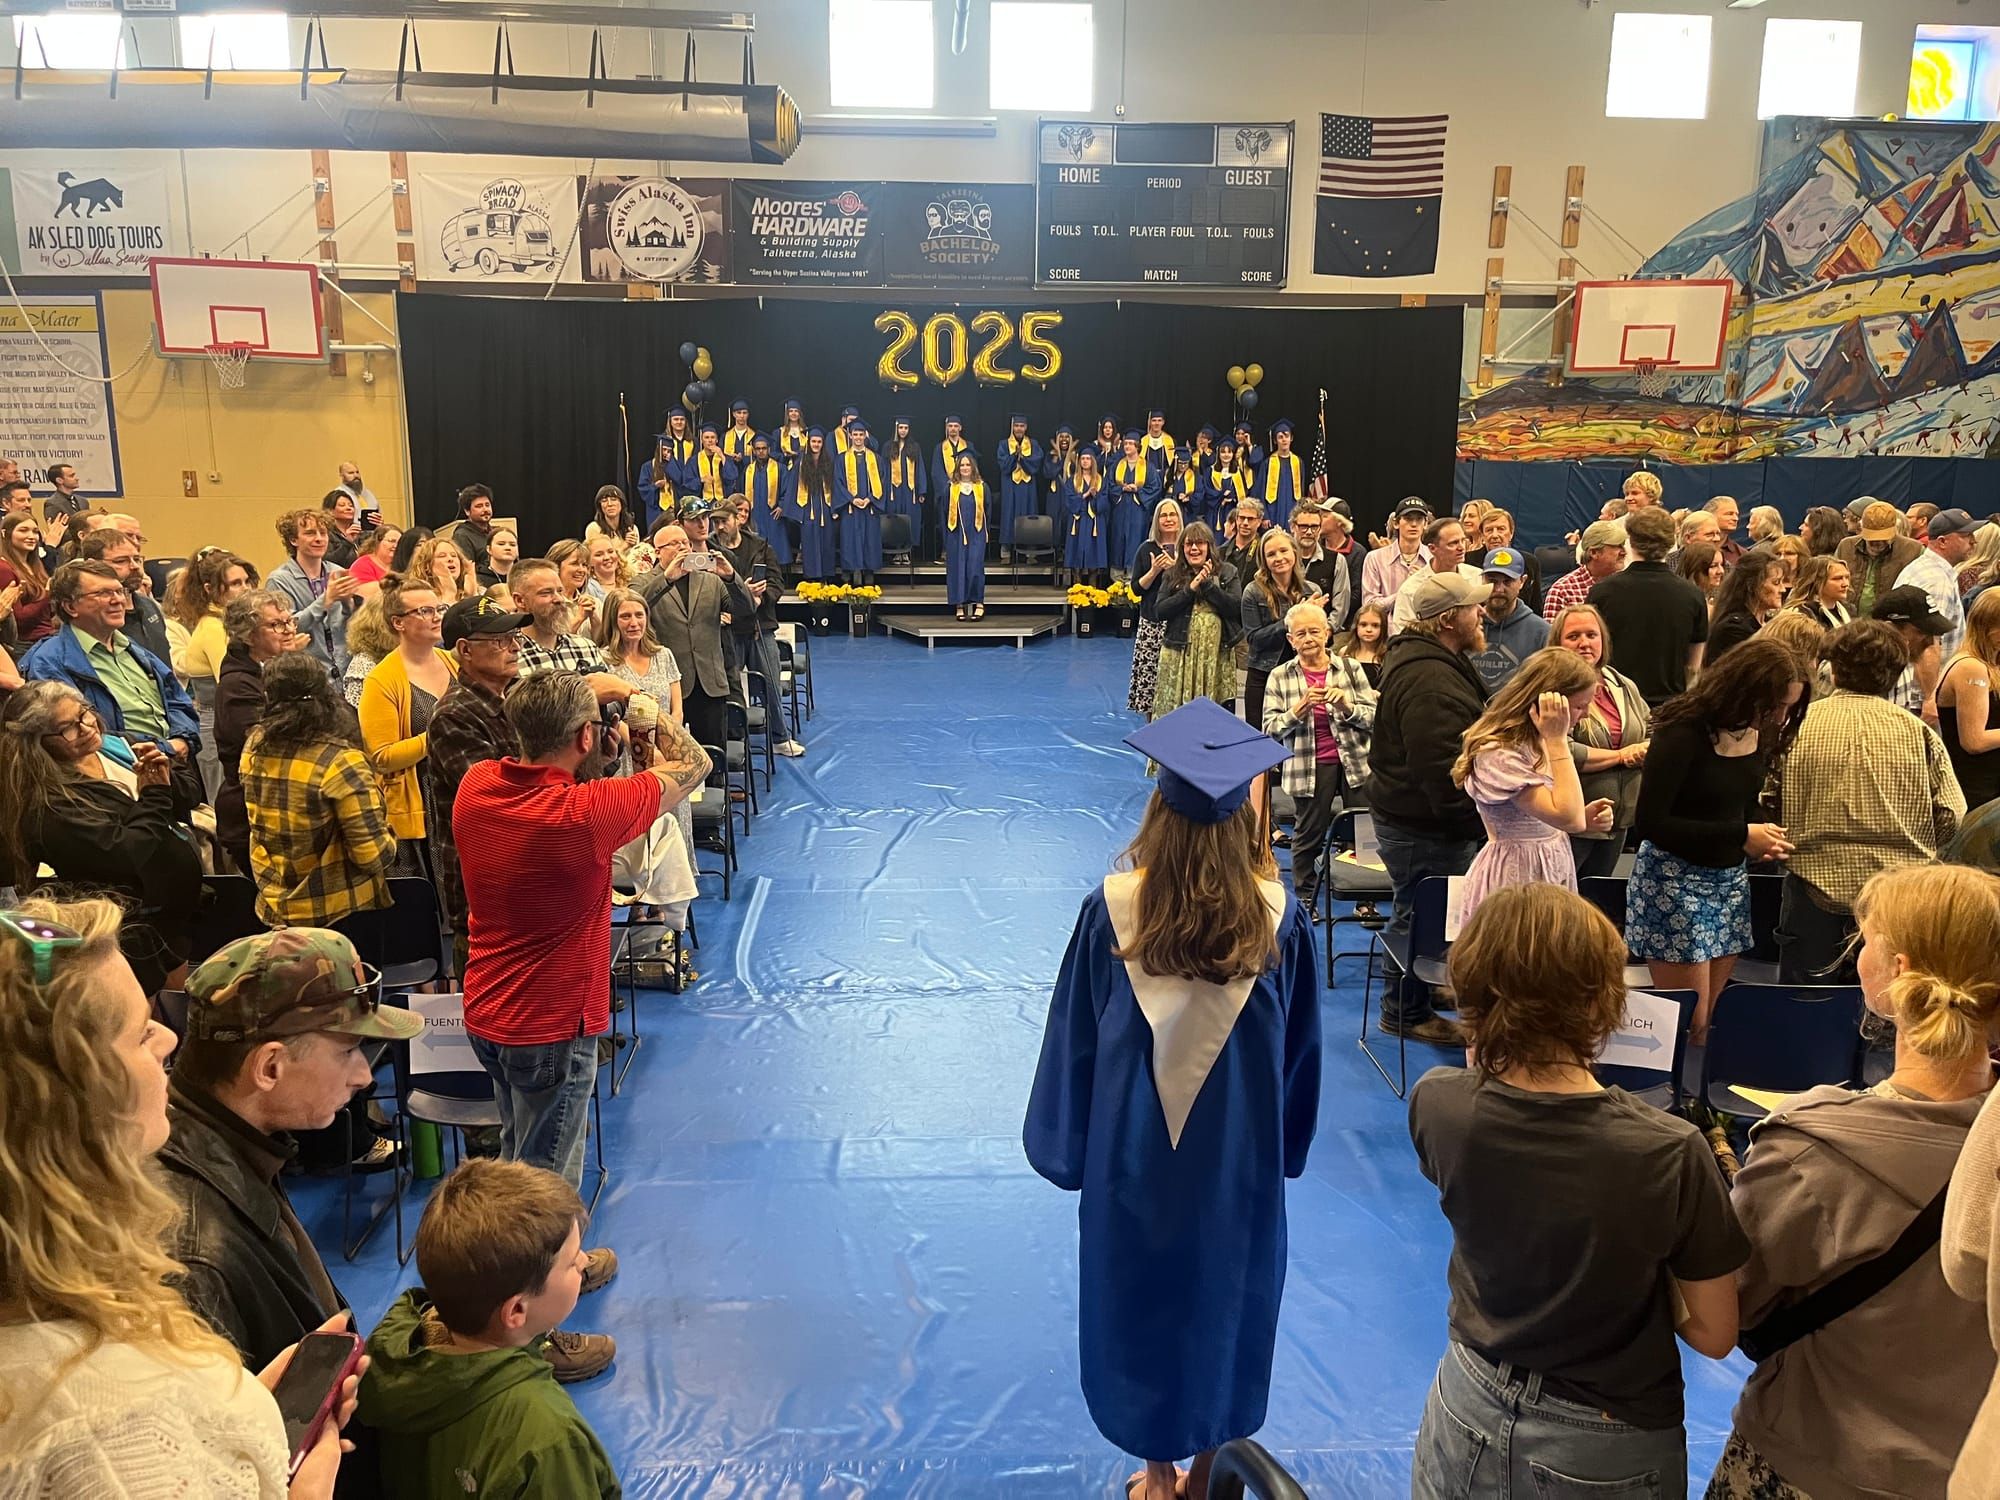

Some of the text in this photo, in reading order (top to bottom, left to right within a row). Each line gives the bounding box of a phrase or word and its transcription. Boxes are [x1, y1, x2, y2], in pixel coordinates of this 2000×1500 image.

[1059, 168, 1100, 183] HOME
[1225, 170, 1272, 186] GUEST
[1147, 178, 1181, 189] PERIOD
[483, 184, 521, 201] SPINACH
[488, 197, 516, 210] BREAD
[751, 197, 827, 217] Moores'
[614, 186, 695, 239] Swiss Alaska Inn
[751, 216, 868, 237] HARDWARE
[1050, 225, 1274, 239] FOULS T.O.L. PLAYER FOUL T.O.L. FOULS
[28, 226, 164, 249] AK SLED DOG TOURS
[760, 237, 860, 248] & Building Supply
[920, 238, 1000, 254] BACHELOR
[763, 248, 857, 259] Talkeetna, Alaska
[928, 252, 990, 264] SOCIETY
[1049, 269, 1080, 280] SCORE
[1144, 270, 1178, 281] MATCH
[1241, 271, 1272, 282] SCORE
[27, 309, 81, 327] Mater
[874, 310, 1063, 390] 2025
[3, 449, 25, 458] FIGHT
[26, 449, 36, 458] ON
[37, 449, 47, 458] TO
[1623, 1017, 1653, 1030] LICH
